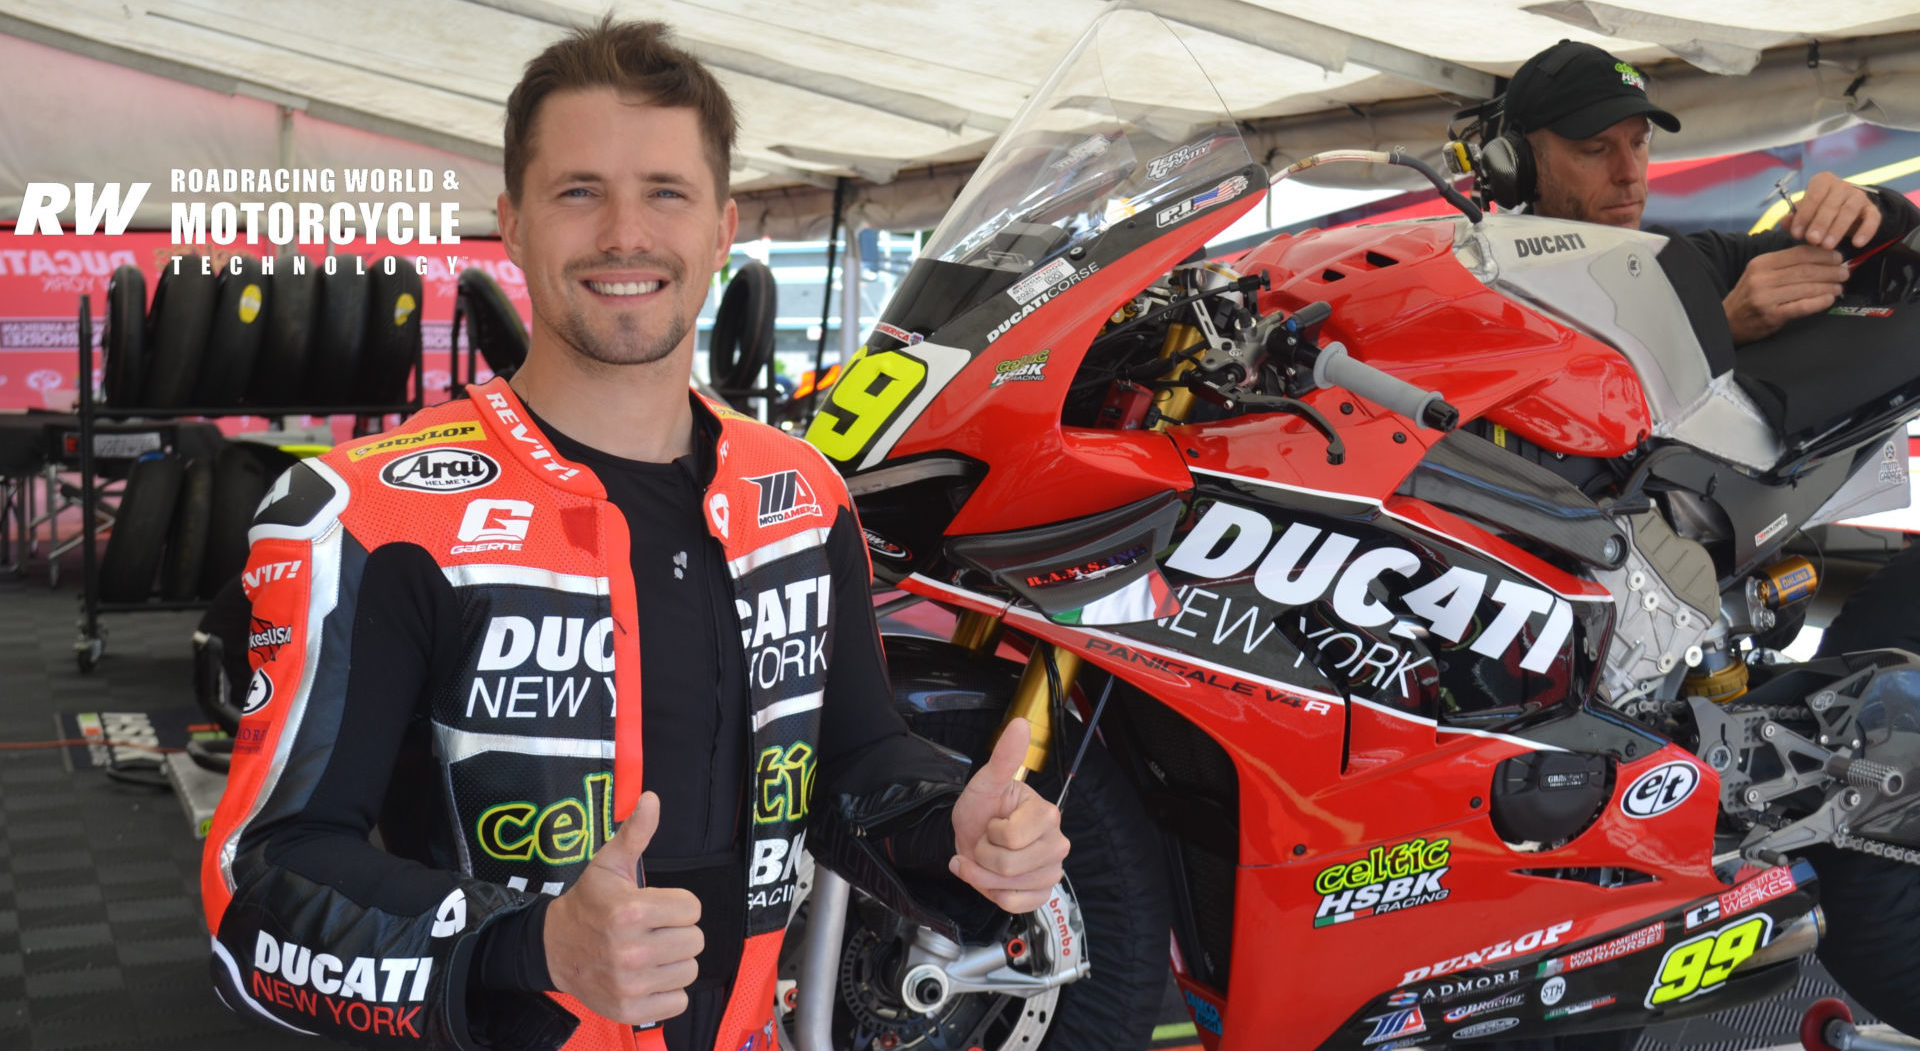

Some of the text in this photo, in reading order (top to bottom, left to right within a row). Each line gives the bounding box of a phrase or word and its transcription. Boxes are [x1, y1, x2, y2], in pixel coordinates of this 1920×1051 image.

[1515, 233, 1586, 258] DUCATI
[377, 427, 475, 449] DUNLOP
[395, 454, 486, 484] Arai
[759, 504, 821, 526] MOTOAMERICA
[1165, 501, 1574, 675] DUCATI
[1085, 638, 1258, 696] PANIGALE
[465, 676, 592, 718] NEW
[1315, 838, 1450, 894] celtic
[1721, 865, 1788, 904] COMPETITION
[1315, 866, 1450, 918] HSBK
[1375, 889, 1450, 915] RACING
[1723, 878, 1793, 914] WERKES
[1049, 897, 1072, 957] brembo
[1570, 923, 1662, 961] NORTH AMERICAN
[253, 930, 433, 1003] DUCATI
[1398, 920, 1574, 988] DUNLOP
[1652, 917, 1764, 1006] 99
[1422, 969, 1520, 999] ADMORE
[1542, 982, 1564, 999] STM
[253, 971, 422, 1038] NEW YORK
